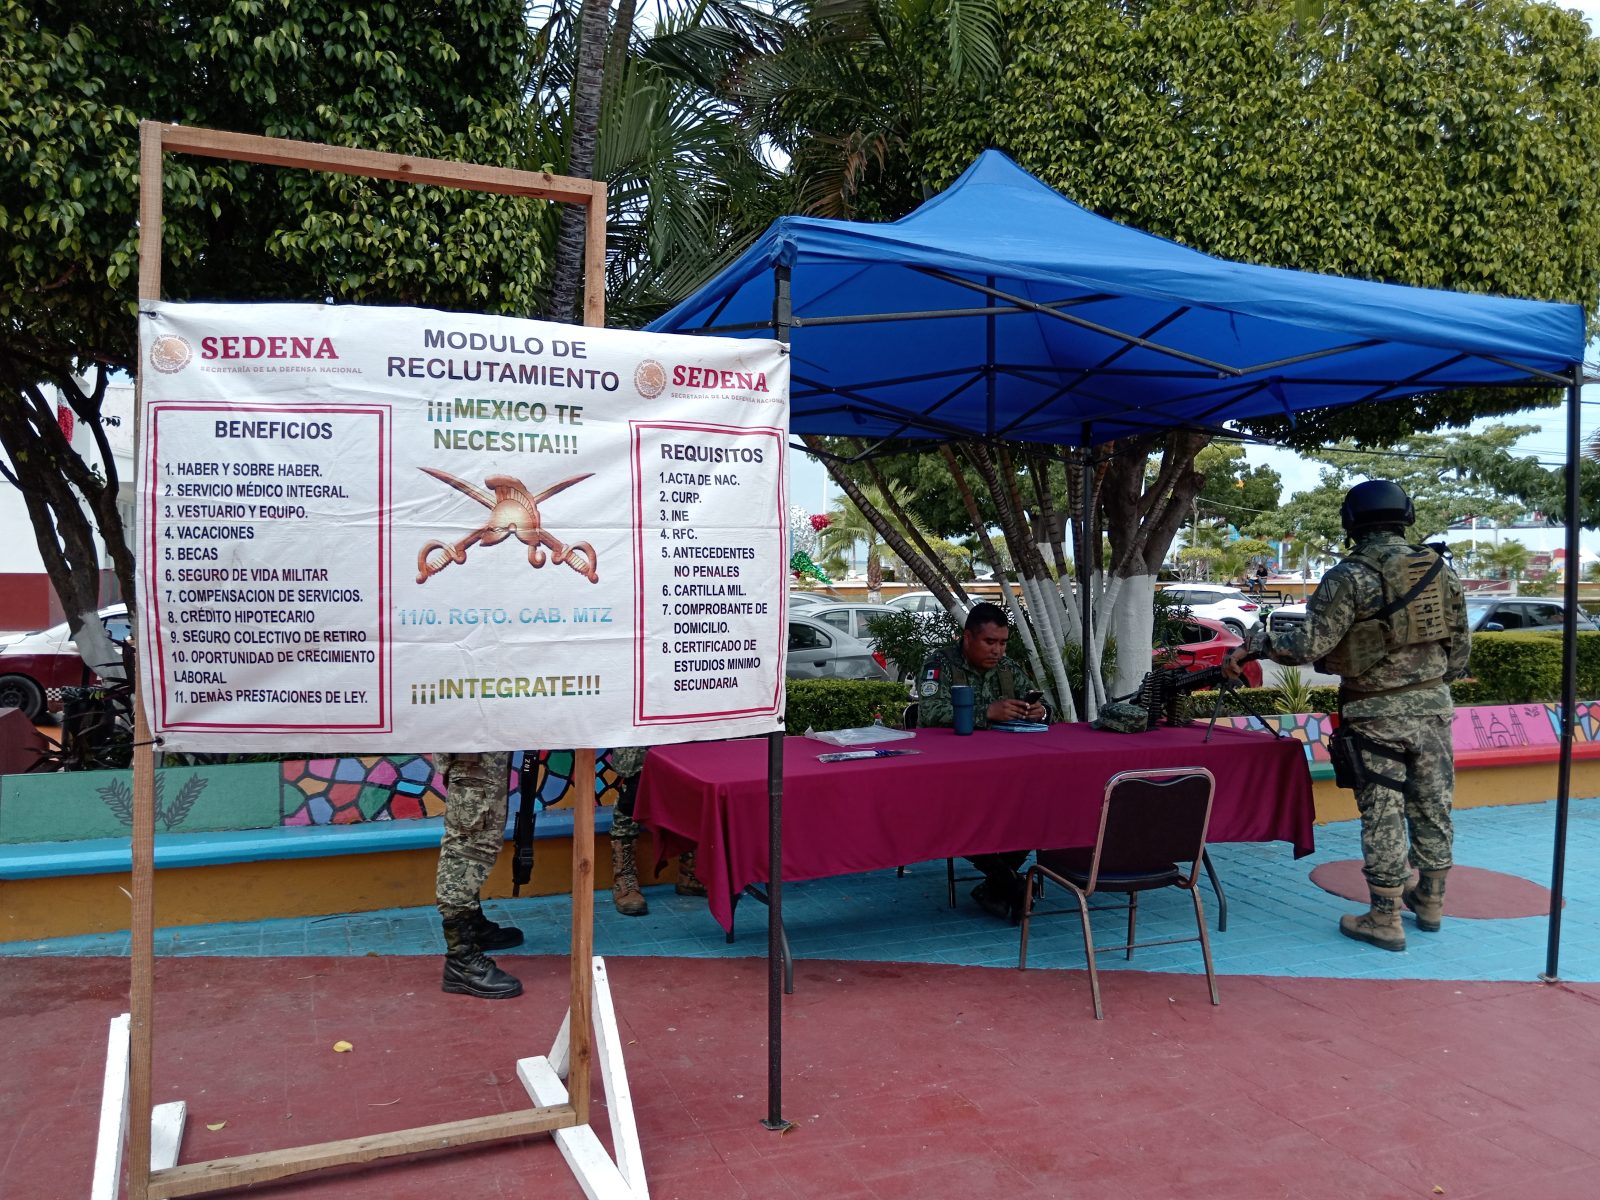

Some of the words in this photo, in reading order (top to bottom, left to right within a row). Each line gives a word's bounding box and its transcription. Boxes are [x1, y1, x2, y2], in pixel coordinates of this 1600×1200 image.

[201, 336, 339, 360] SEDENA
[424, 329, 544, 355] MODULO
[552, 340, 587, 359] DE
[253, 366, 264, 374] DE
[267, 366, 276, 374] LA
[280, 366, 317, 374] DEFENSA
[320, 366, 362, 374] NACIONAL
[387, 356, 620, 392] RECLUTAMIENTO
[672, 365, 769, 393] SEDENA
[555, 405, 584, 426] TE
[215, 420, 333, 440] BENEFICIOS
[434, 428, 578, 455] NECESITA!!!
[661, 444, 764, 463] REQUISITOS
[165, 463, 174, 476] 1.
[177, 463, 219, 476] HABER
[223, 463, 230, 476] Y
[233, 463, 275, 477] SOBRE
[278, 464, 323, 478] HABER.
[698, 474, 711, 486] DE
[714, 475, 740, 486] NAC.
[164, 484, 174, 497] 2.
[177, 484, 233, 498] SERVICIO
[236, 481, 283, 498] MÉDICO
[286, 485, 349, 498] INTEGRAL.
[660, 491, 669, 502] 2.
[671, 492, 702, 503] CURP.
[165, 505, 174, 518] 3.
[177, 505, 246, 518] VESTUARIO
[249, 506, 256, 518] Y
[259, 506, 308, 520] EQUIPO.
[660, 510, 669, 521] 3.
[671, 510, 689, 522] INE
[164, 526, 174, 540] 4.
[177, 526, 254, 540] VACACIONES
[660, 529, 670, 539] 4.
[672, 528, 698, 540] RFC.
[165, 548, 174, 561] 5.
[178, 548, 218, 561] BECAS
[662, 547, 671, 558] 5.
[673, 547, 755, 560] ANTECEDENTES
[165, 569, 175, 582] 6.
[178, 569, 229, 582] SEGURO
[232, 569, 248, 582] DE
[251, 569, 280, 582] VIDA
[282, 569, 328, 582] MILITAR
[674, 566, 690, 578] NO
[693, 566, 740, 578] PENALES
[166, 590, 176, 603] 7.
[179, 590, 275, 603] COMPENSACION
[279, 590, 294, 602] DE
[298, 589, 363, 603] SERVICIOS.
[662, 586, 672, 596] 6.
[674, 584, 725, 596] CARTILLA
[728, 585, 747, 596] MIL.
[168, 611, 178, 624] 8.
[180, 607, 232, 623] CRÉDITO
[235, 610, 315, 623] HIPOTECARIO
[450, 608, 511, 625] RGTO.
[519, 608, 566, 624] CAB.
[574, 608, 613, 623] MTZ
[662, 604, 672, 616] 7.
[674, 603, 753, 615] COMPROBANTE
[755, 603, 768, 614] DE
[674, 622, 730, 634] DOMICILIO.
[170, 632, 180, 644] 9.
[183, 630, 231, 644] SEGURO
[234, 631, 301, 644] COLECTIVO
[304, 631, 320, 643] DE
[324, 630, 366, 642] RETIRO
[662, 642, 671, 654] 8.
[674, 640, 742, 653] CERTIFICADO
[744, 640, 757, 650] DE
[172, 651, 188, 664] 10.
[191, 651, 274, 664] OPORTUNIDAD
[277, 651, 294, 663] DE
[297, 650, 375, 663] CRECIMIENTO
[674, 659, 725, 672] ESTUDIOS
[727, 657, 761, 670] MINIMO
[174, 670, 227, 684] LABORAL
[674, 677, 738, 692] SECUNDARIA
[175, 691, 188, 704] 11.
[236, 690, 322, 703] PRESTACIONES
[325, 691, 341, 704] DE
[344, 691, 368, 704] LEY.
